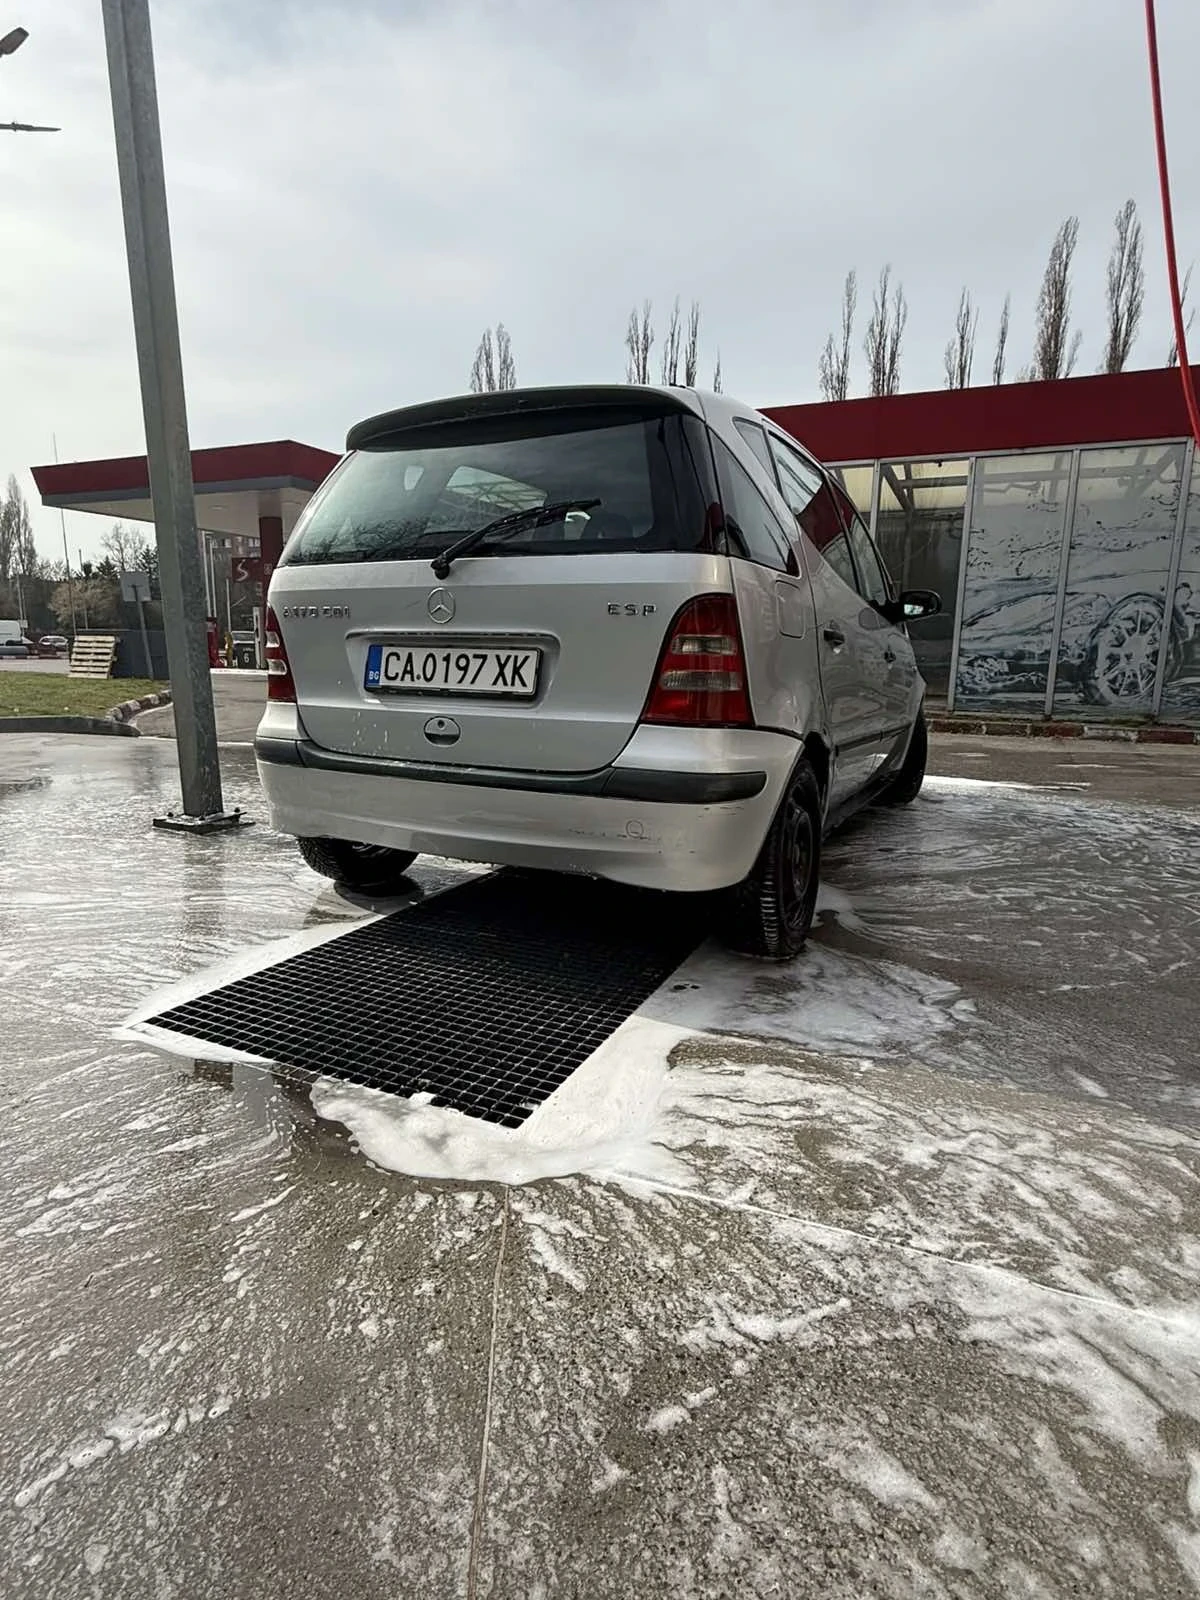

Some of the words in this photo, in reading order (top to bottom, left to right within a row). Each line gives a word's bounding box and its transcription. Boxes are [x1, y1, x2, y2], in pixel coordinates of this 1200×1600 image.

[607, 602, 657, 616] ESP
[368, 670, 380, 681] BG
[491, 654, 531, 688] XK
